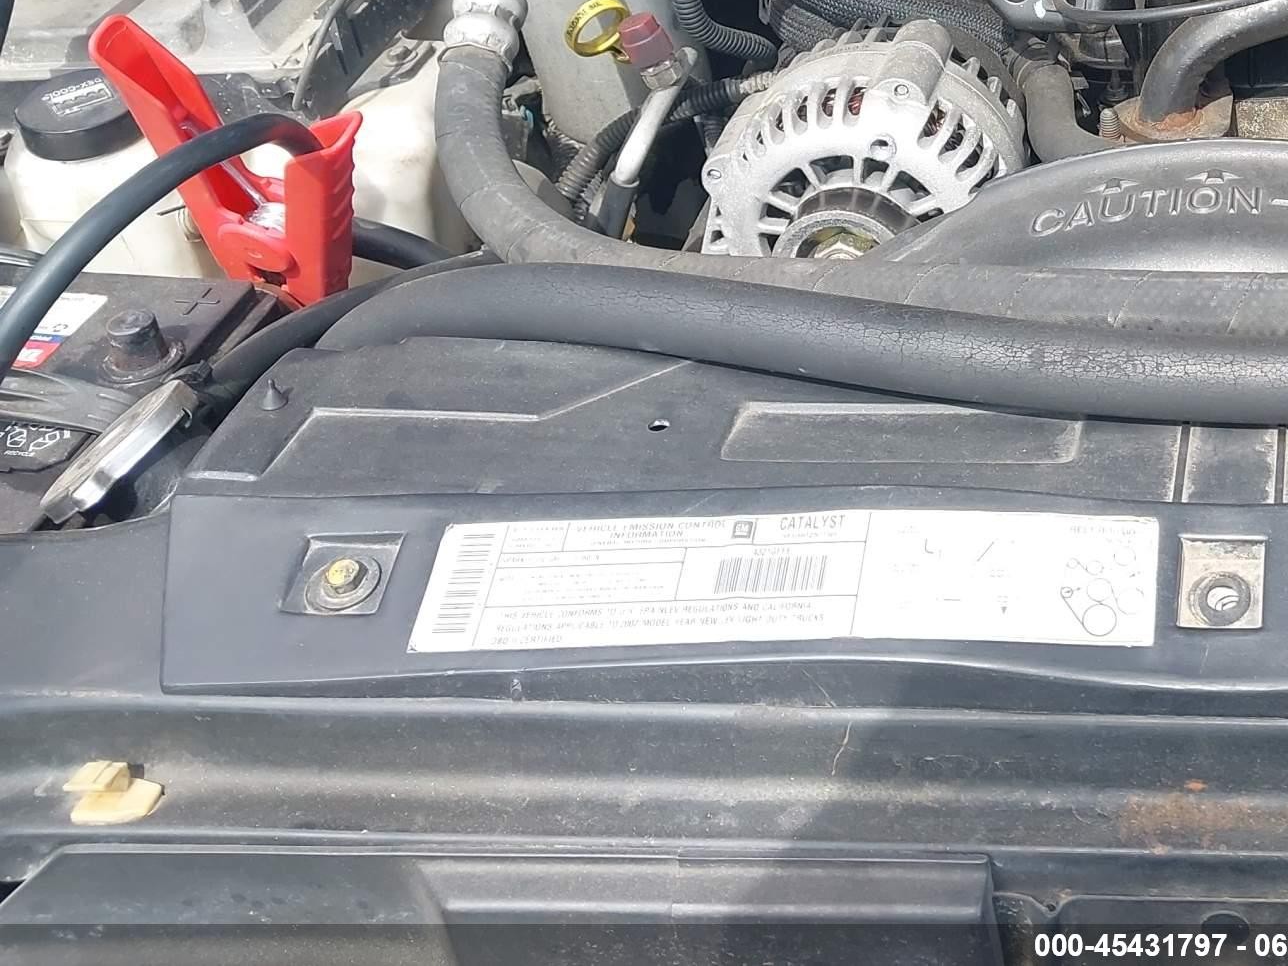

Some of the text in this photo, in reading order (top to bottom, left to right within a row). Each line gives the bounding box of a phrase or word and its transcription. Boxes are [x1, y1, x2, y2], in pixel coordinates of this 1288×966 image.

[623, 521, 675, 531] EMISSION
[679, 519, 728, 530] CONTROL
[780, 514, 846, 531] CATALYST
[610, 530, 684, 540] INFORMATION
[743, 602, 760, 611] AND
